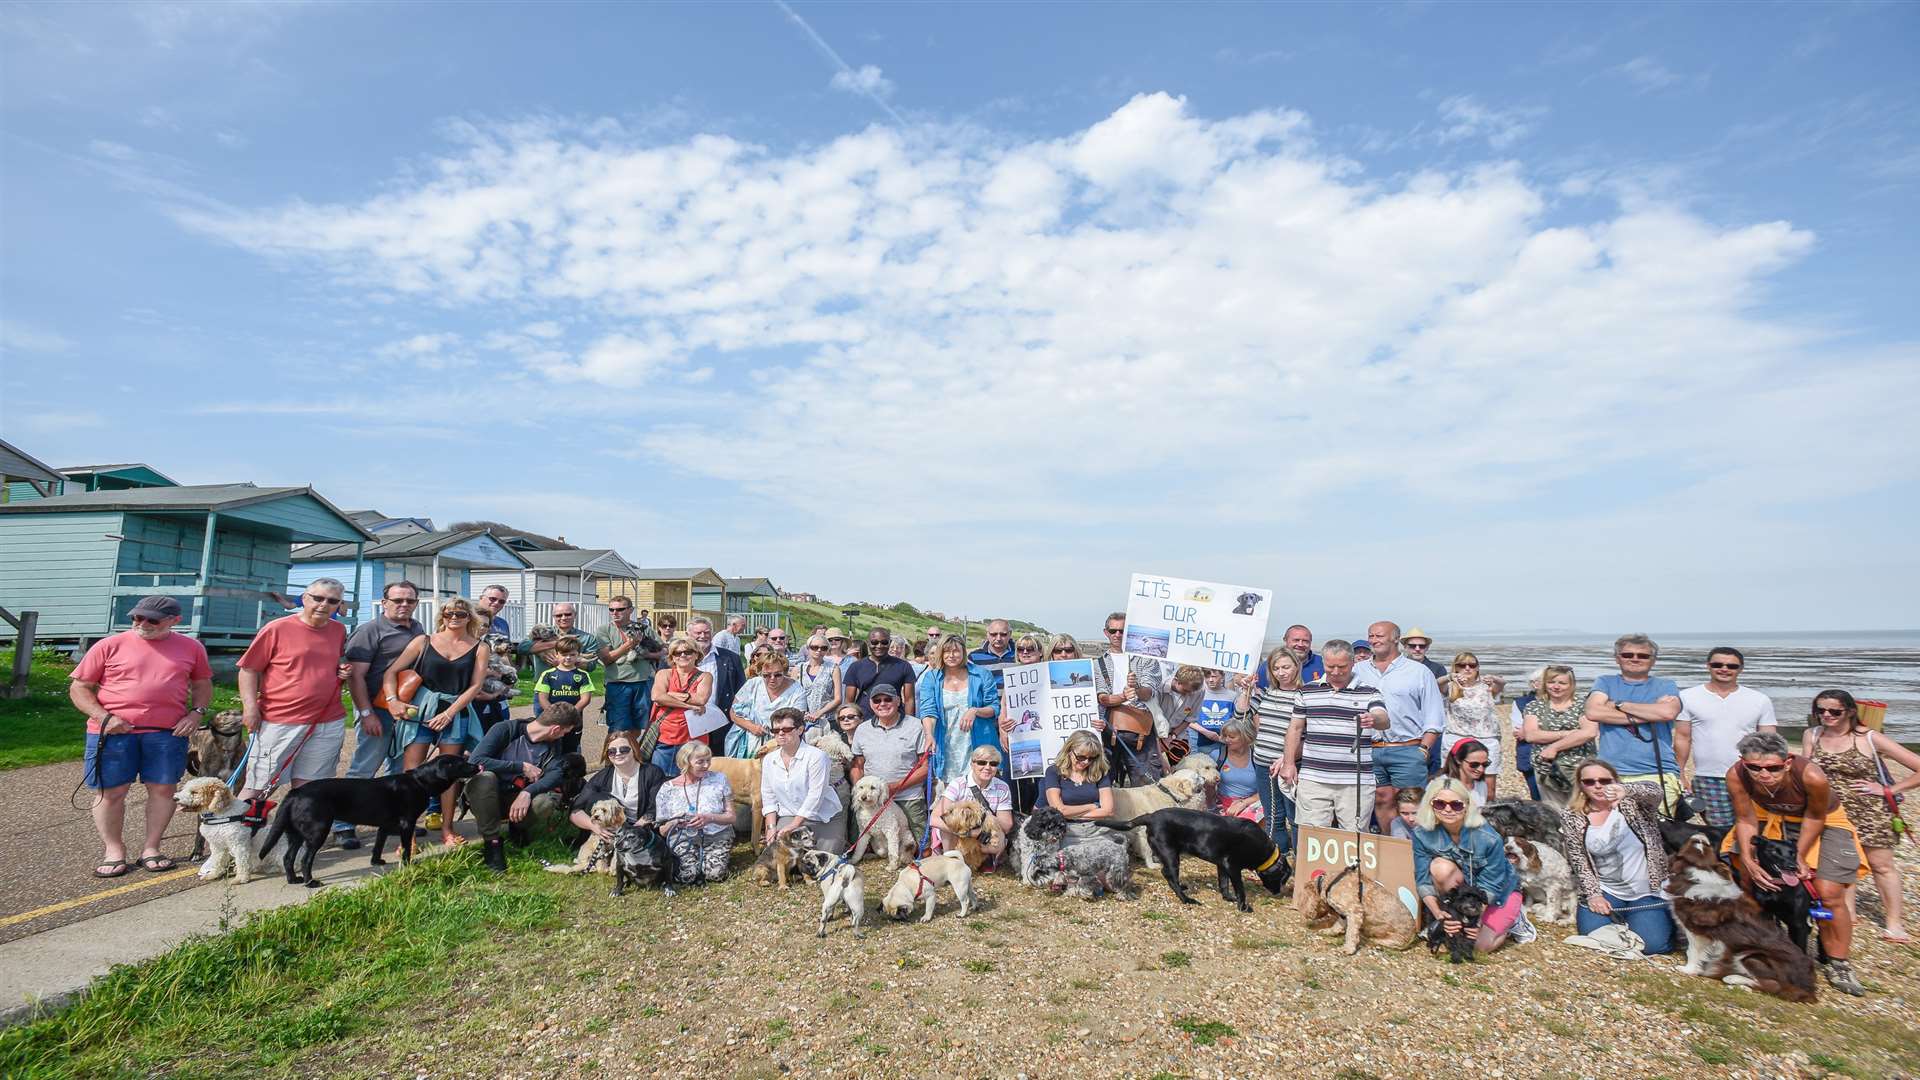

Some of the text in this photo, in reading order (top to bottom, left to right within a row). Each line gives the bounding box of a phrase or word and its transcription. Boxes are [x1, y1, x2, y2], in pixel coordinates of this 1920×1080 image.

[1136, 579, 1171, 599] IT'S
[1163, 604, 1197, 624] OUR
[1175, 627, 1226, 650] BEACH
[1006, 669, 1039, 688] I DO
[1051, 694, 1091, 709] TO BE
[1307, 836, 1377, 869] DOGS
